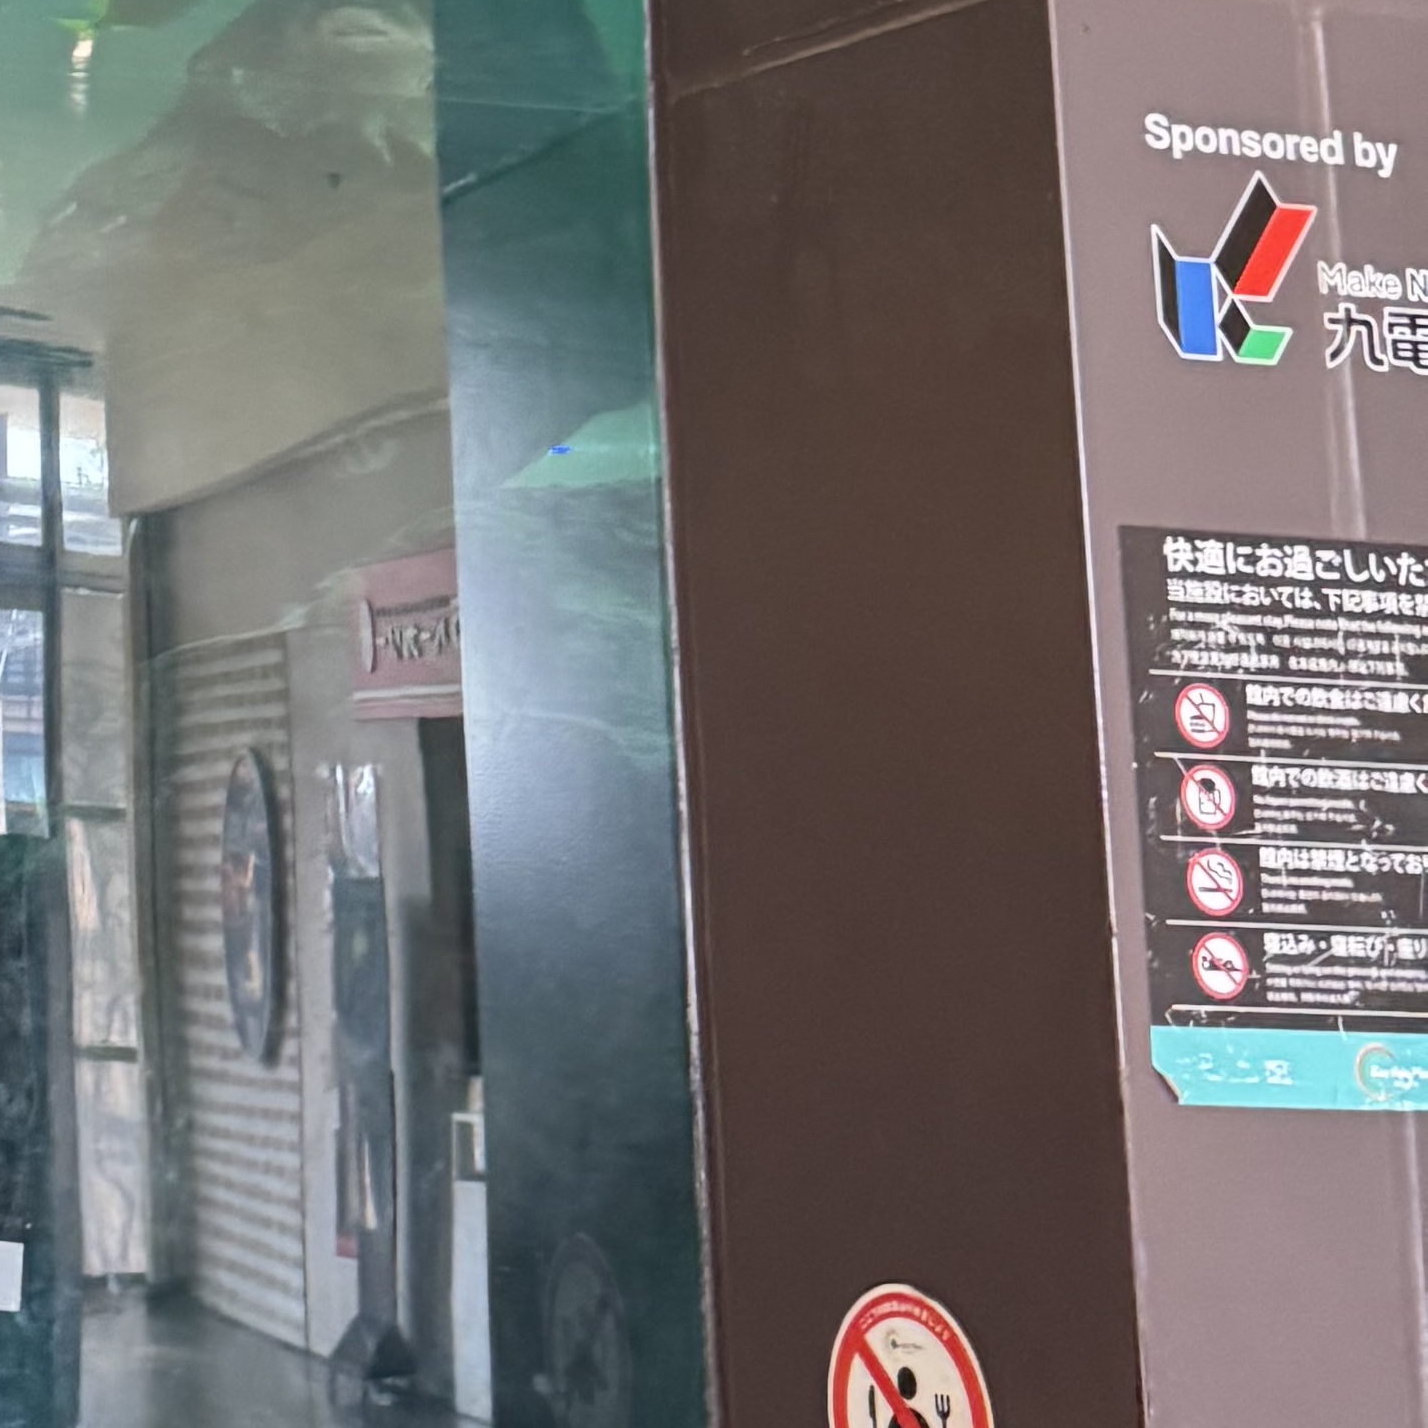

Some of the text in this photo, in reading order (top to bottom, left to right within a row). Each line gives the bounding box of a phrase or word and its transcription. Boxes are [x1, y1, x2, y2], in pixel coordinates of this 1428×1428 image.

[1144, 113, 1398, 178] Sponsored by
[1317, 260, 1402, 300] Make
[1163, 535, 1428, 587] 快適にお過ごしいた
